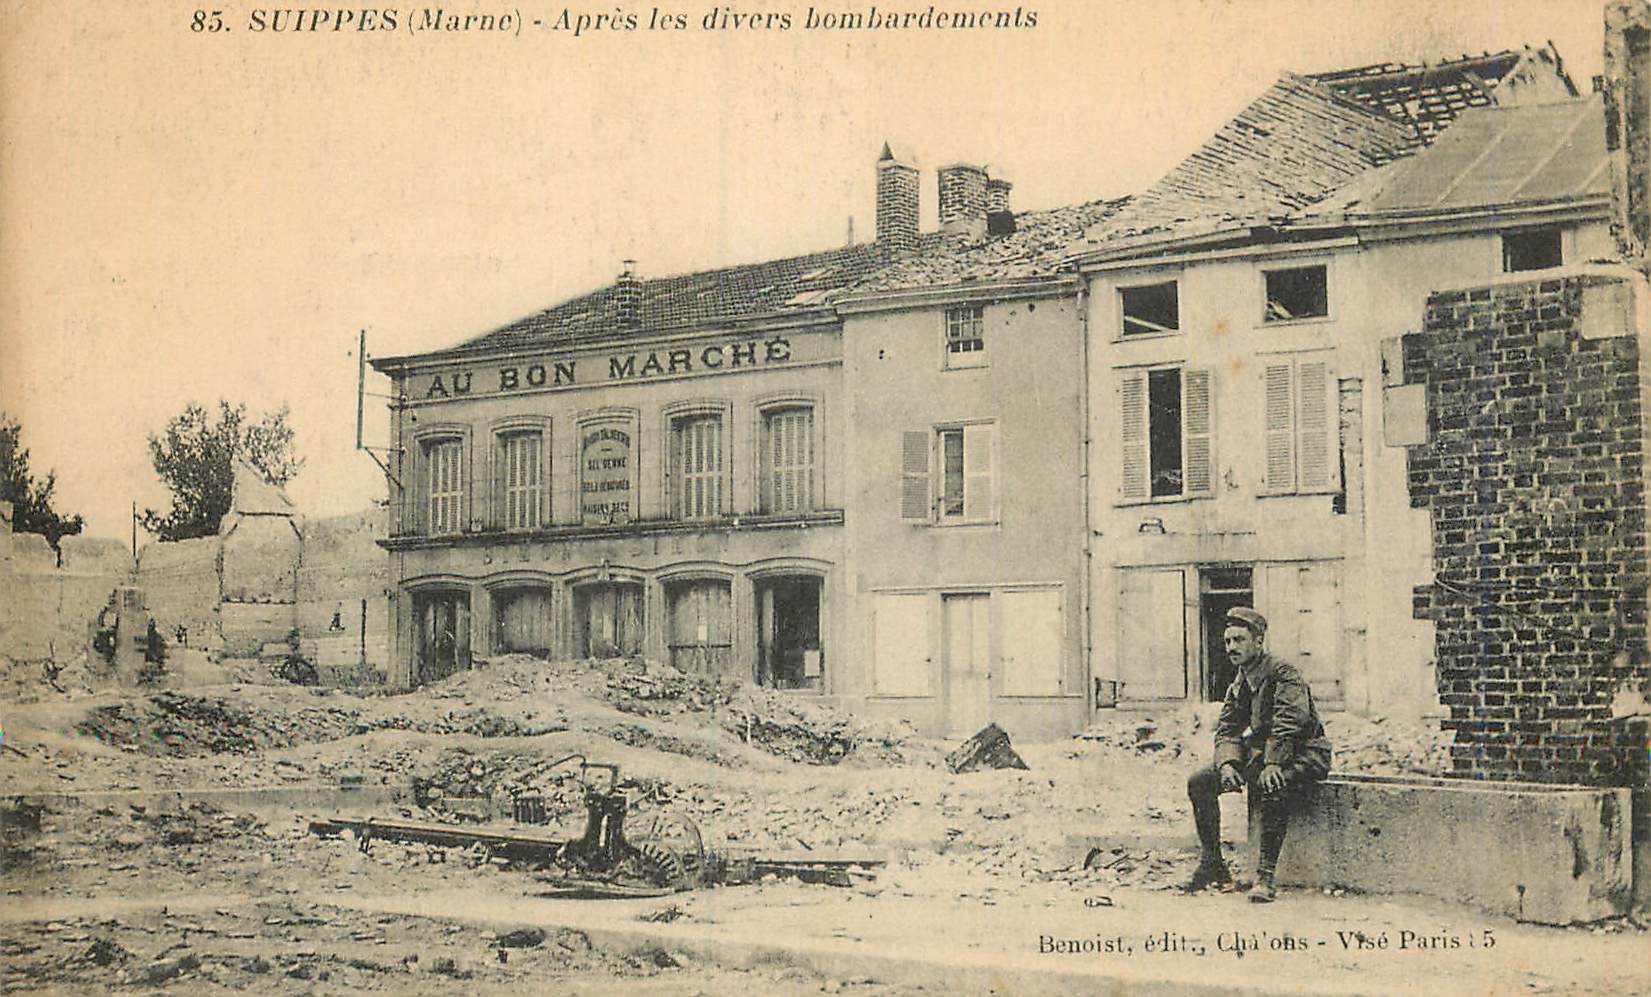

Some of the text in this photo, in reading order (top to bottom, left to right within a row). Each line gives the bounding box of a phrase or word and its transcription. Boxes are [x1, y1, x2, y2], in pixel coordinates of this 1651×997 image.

[427, 336, 792, 399] AU BON MARCHÉ
